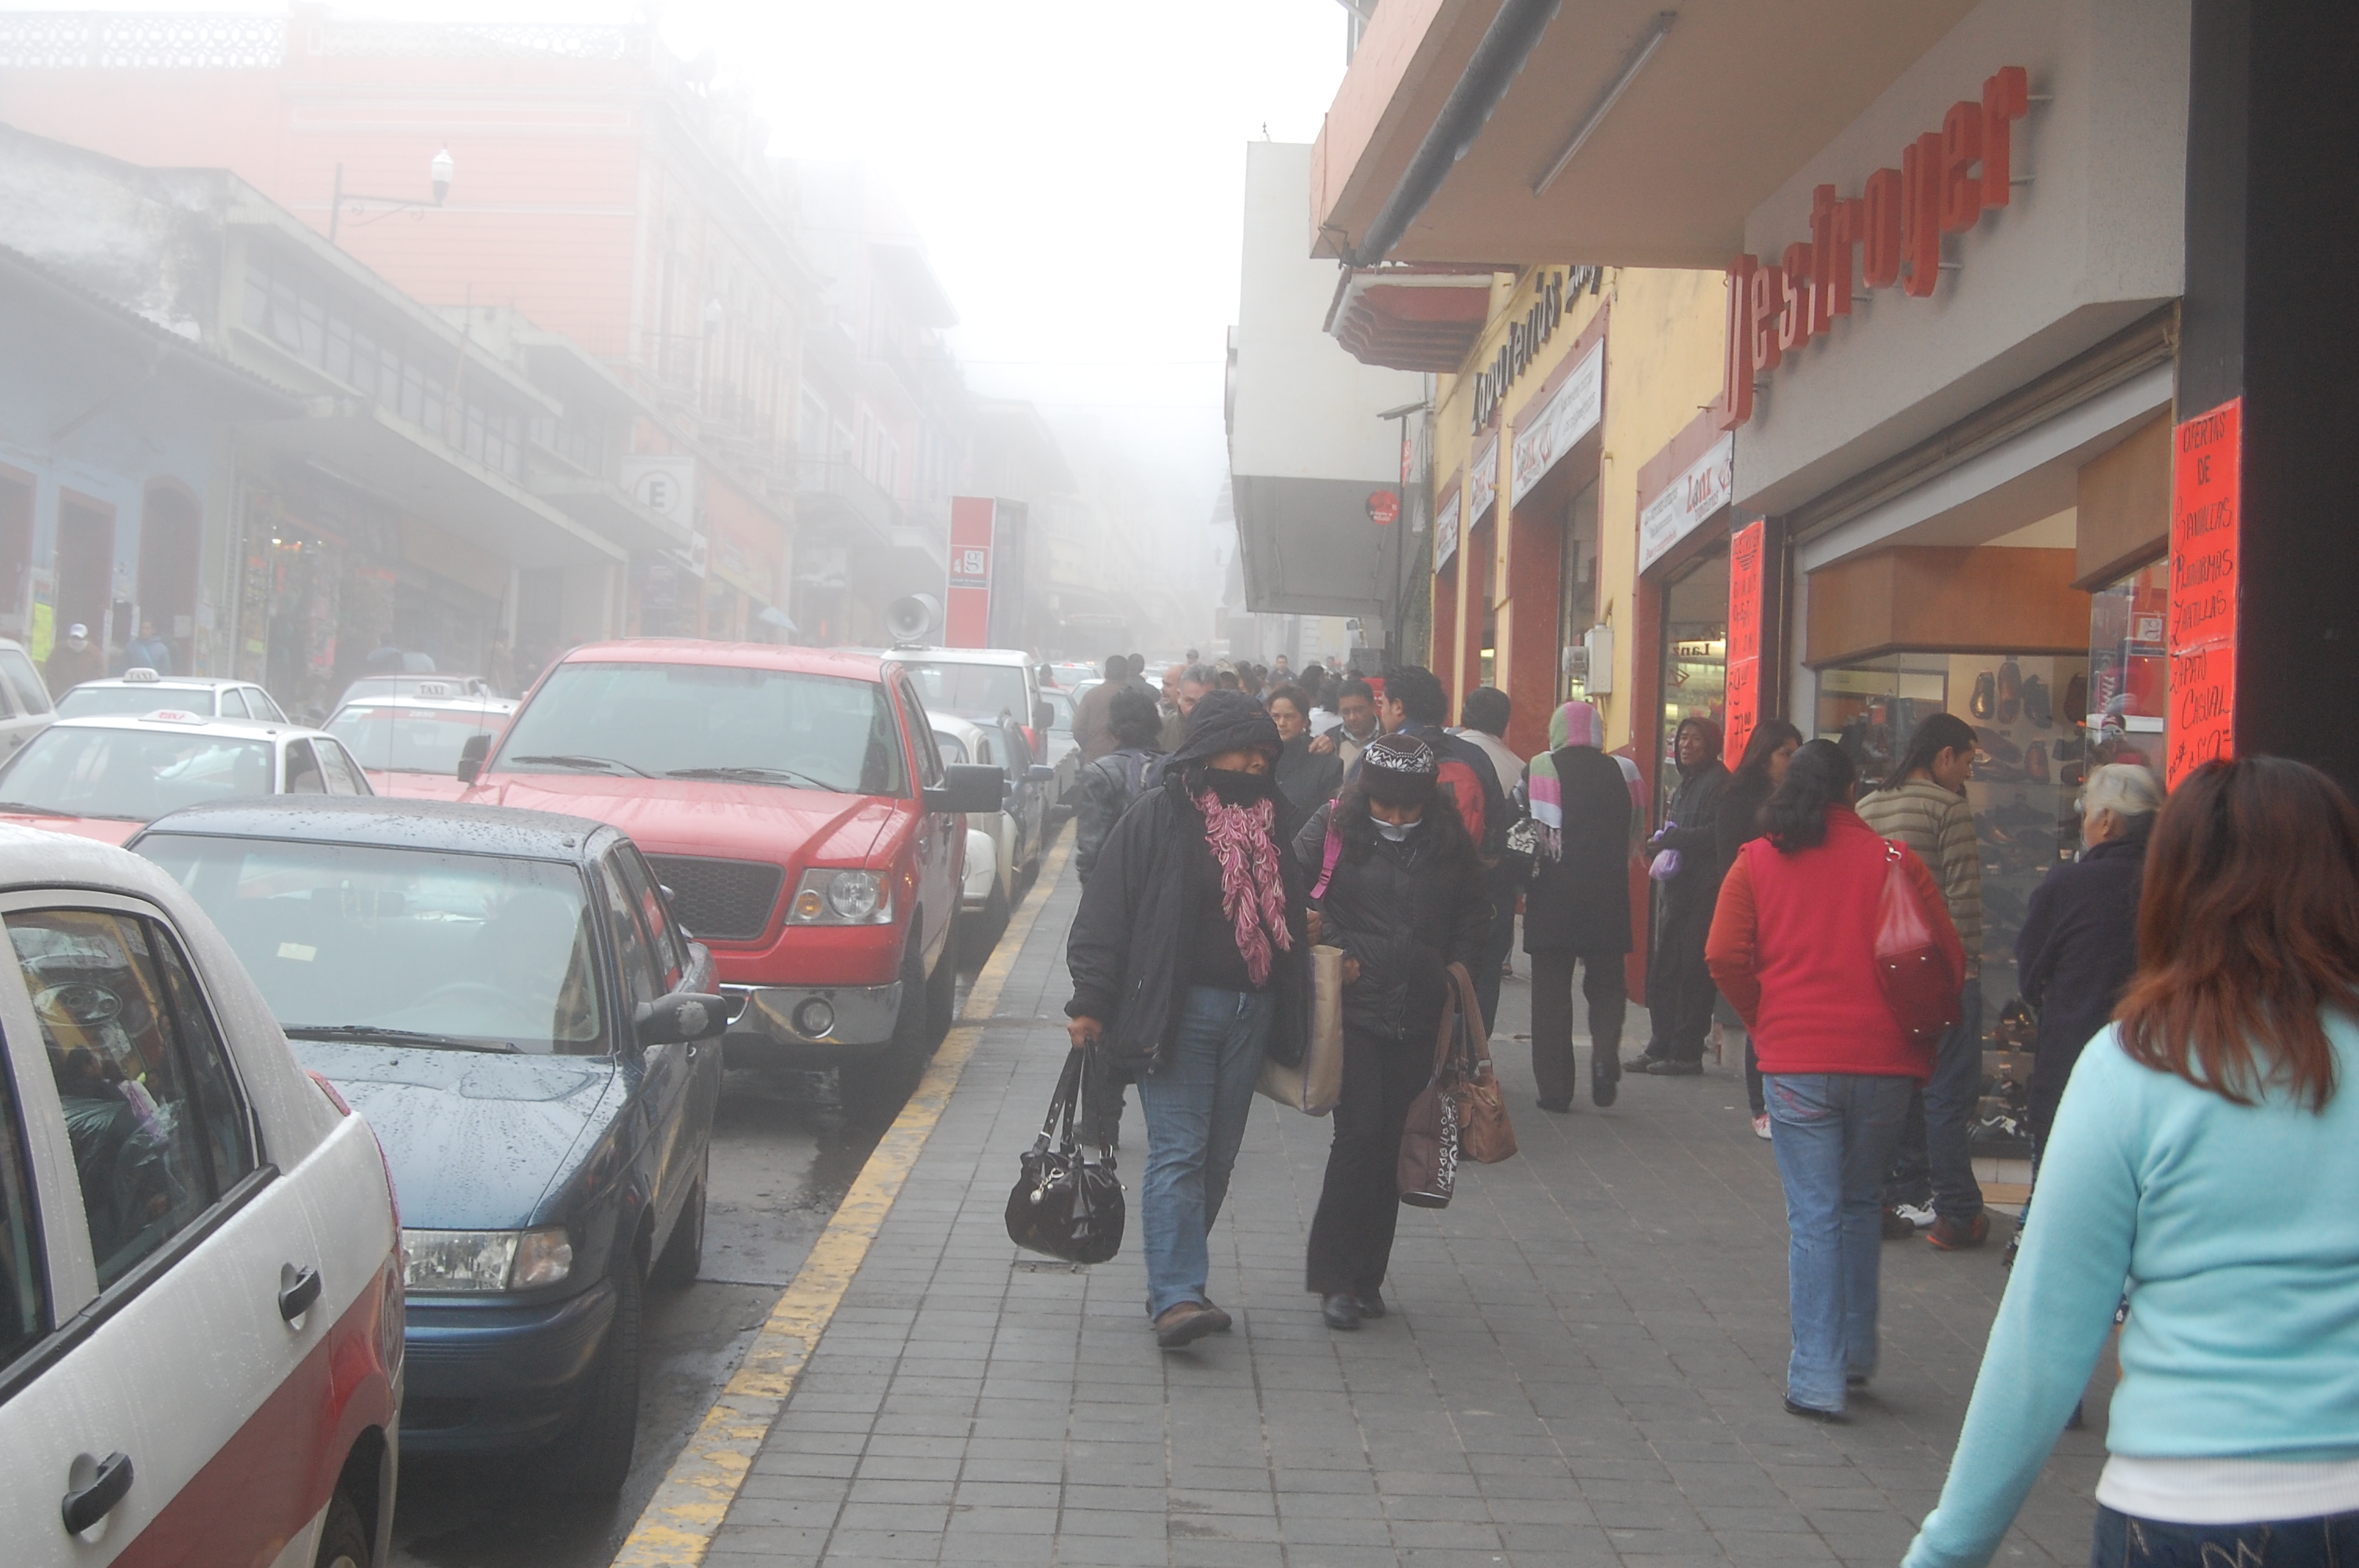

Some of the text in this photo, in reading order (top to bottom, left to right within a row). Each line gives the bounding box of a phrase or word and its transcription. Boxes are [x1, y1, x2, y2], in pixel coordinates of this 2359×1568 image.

[1721, 66, 2028, 430] Destroyer
[2183, 412, 2226, 452] OFERTAS
[2197, 455, 2211, 486] DE
[649, 481, 665, 508] E
[1686, 466, 1713, 514] Lanz
[129, 671, 153, 681] TAXI
[420, 684, 445, 695] TAXI
[2182, 685, 2231, 730] CASUAL
